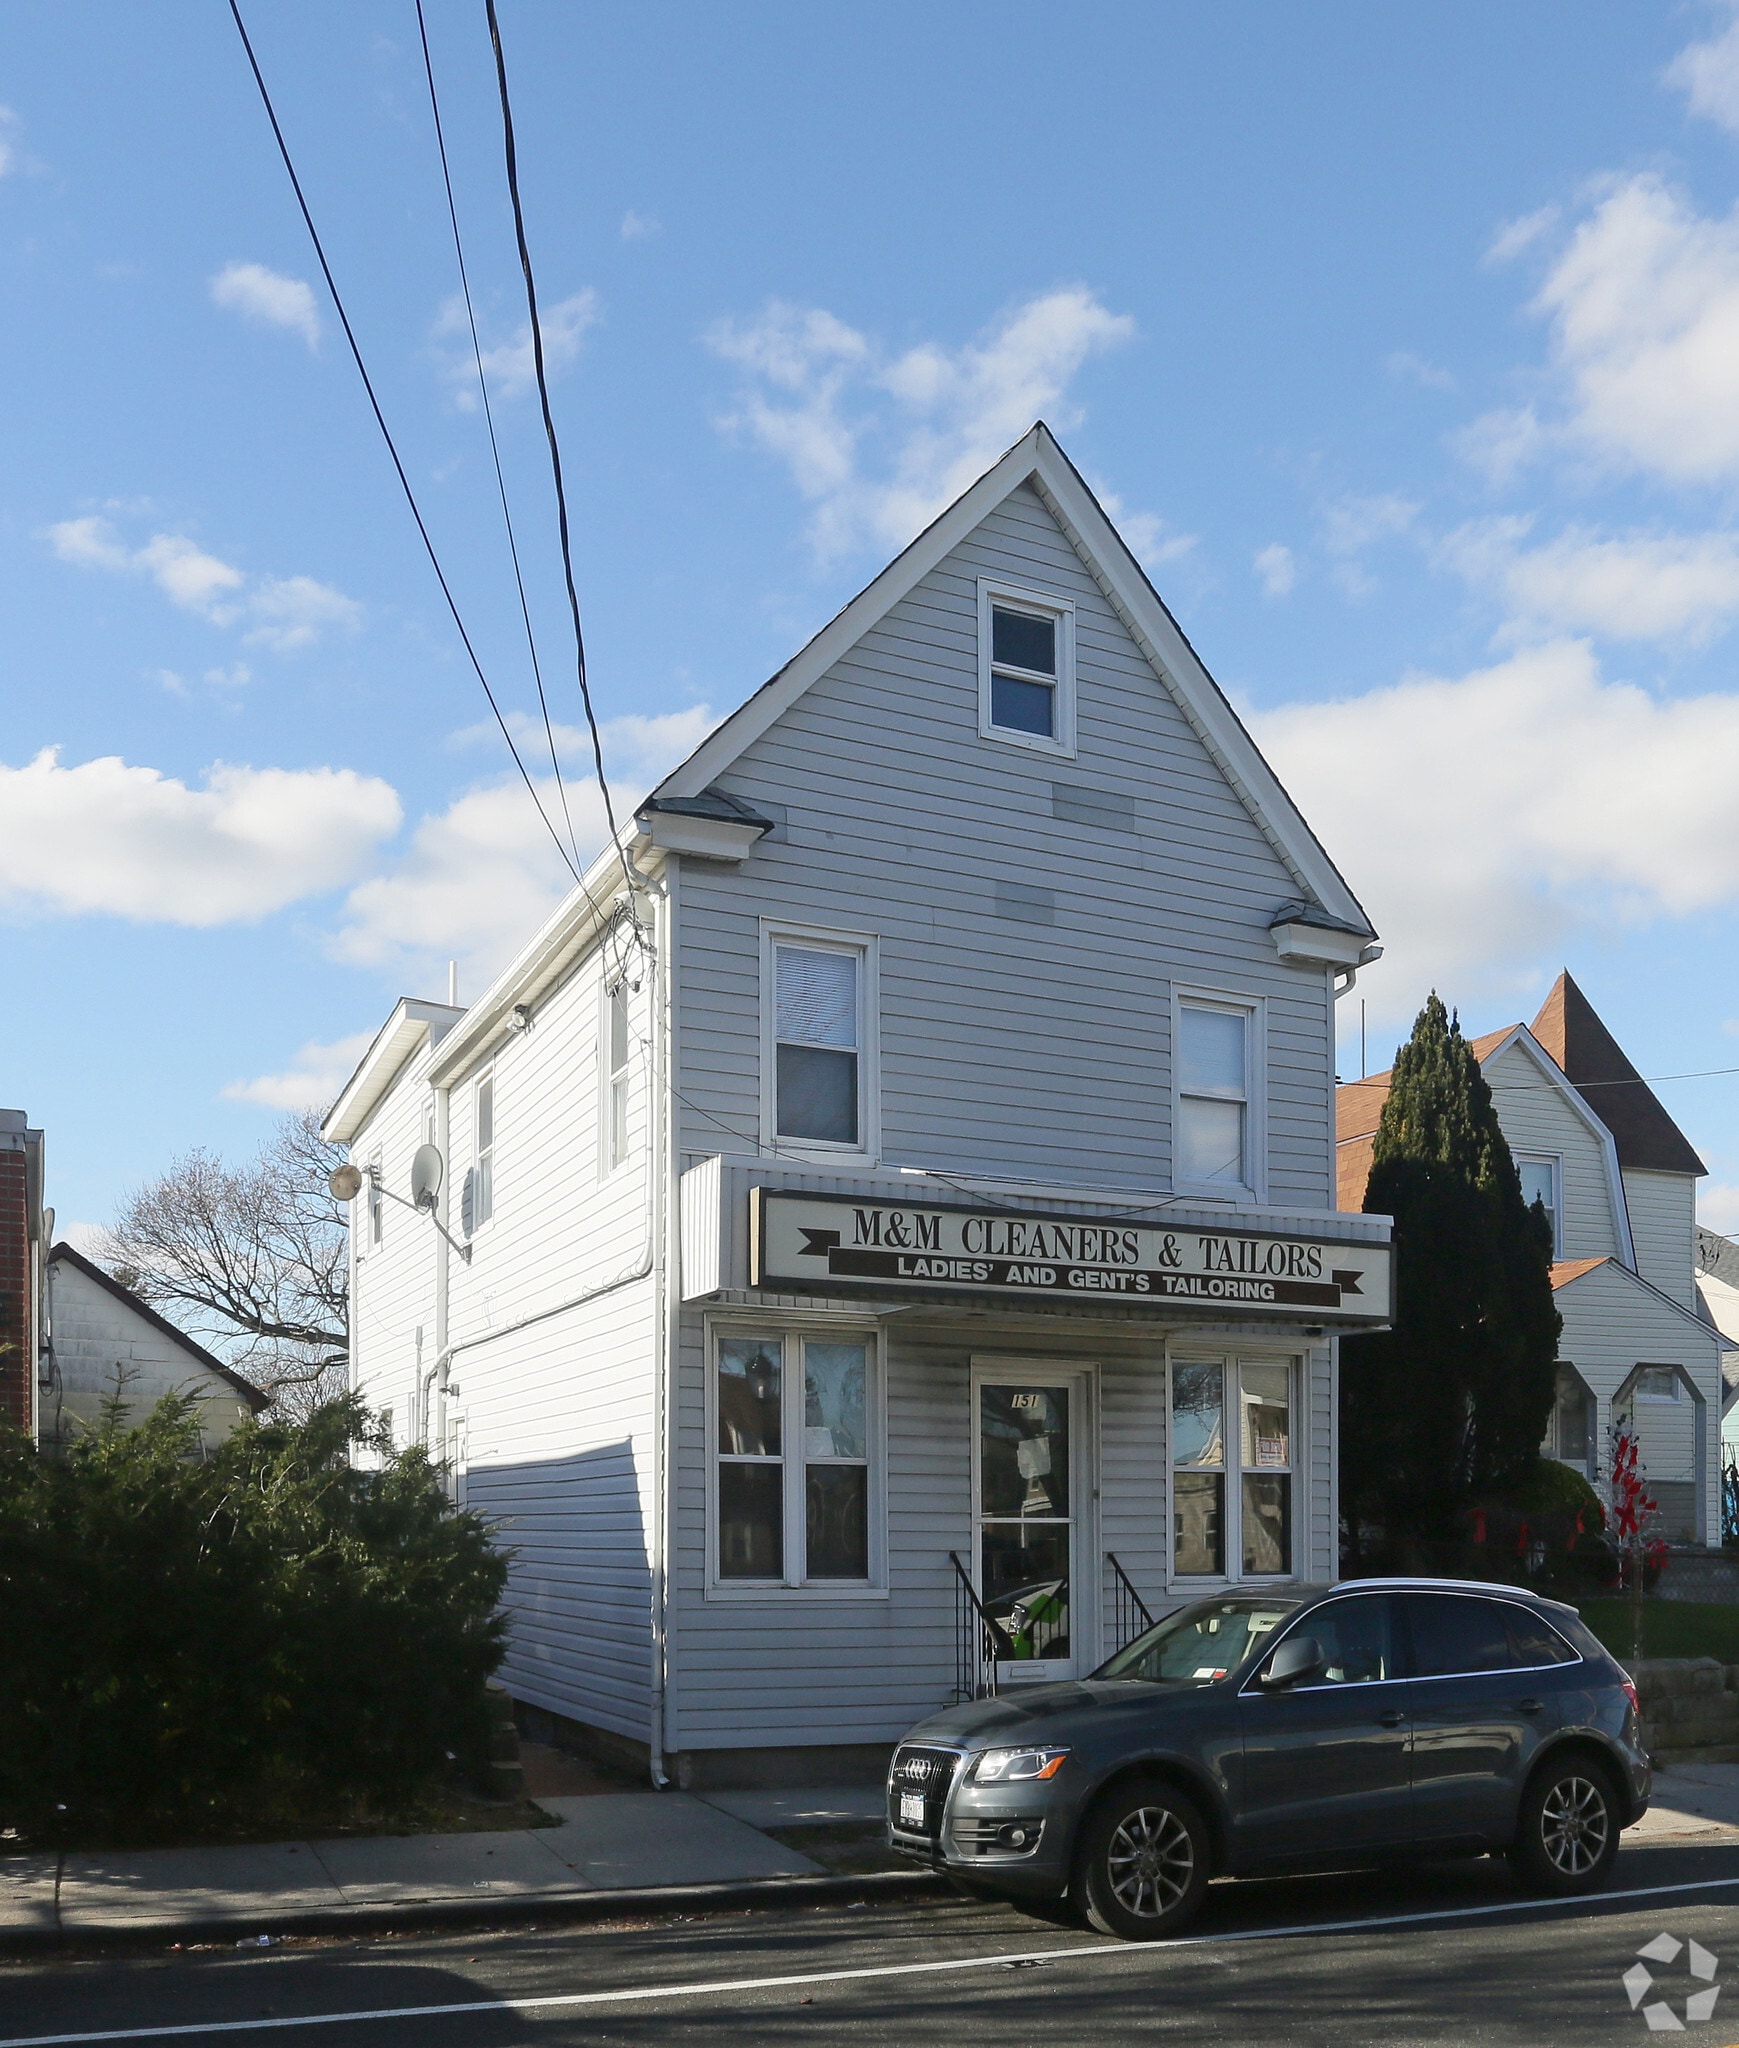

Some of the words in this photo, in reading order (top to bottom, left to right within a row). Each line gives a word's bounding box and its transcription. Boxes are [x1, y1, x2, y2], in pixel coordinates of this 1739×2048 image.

[852, 1208, 943, 1250] M&M
[962, 1218, 1139, 1264] CLEANERS
[1158, 1233, 1183, 1268] &
[1199, 1237, 1323, 1278] TAILORS
[898, 1257, 994, 1281] LADIES'
[1006, 1265, 1057, 1286] AND
[1068, 1269, 1150, 1292] GENT'S
[1162, 1275, 1275, 1300] TAILORING
[1014, 1395, 1037, 1408] 151
